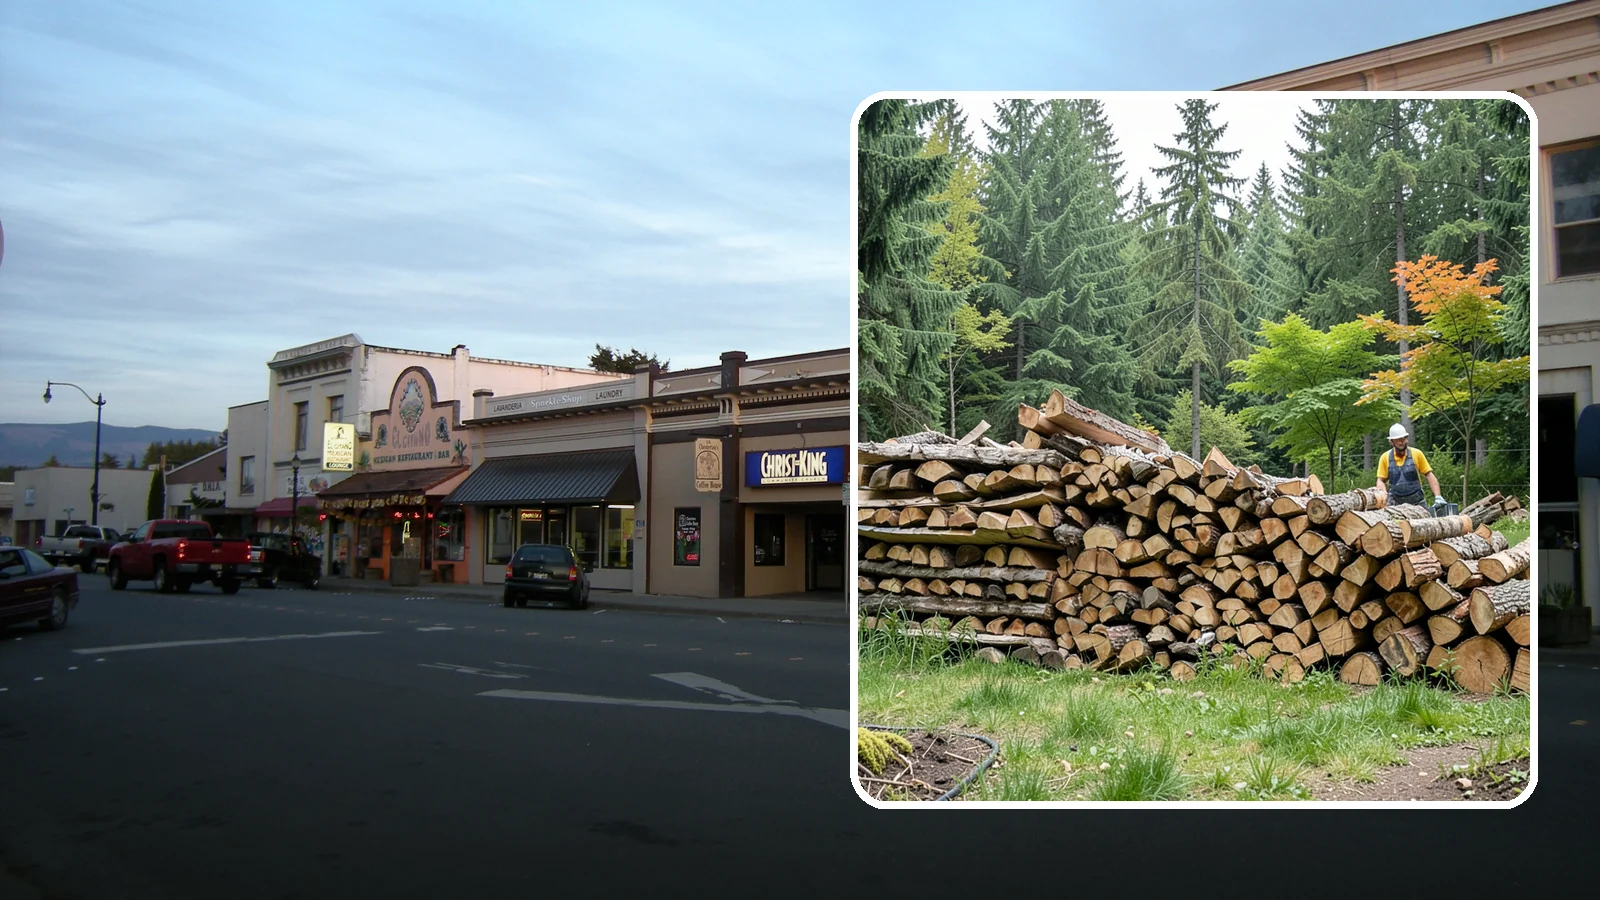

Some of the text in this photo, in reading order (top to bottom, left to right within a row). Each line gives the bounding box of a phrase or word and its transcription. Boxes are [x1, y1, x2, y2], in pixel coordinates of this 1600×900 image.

[595, 389, 624, 400] LAUNDRY
[494, 402, 522, 412] LAVANDERIA
[531, 394, 582, 409] Sparkle Shop
[397, 451, 433, 462] RESTAURANT
[438, 450, 450, 459] BAR
[761, 450, 827, 478] CHRIST KING
[696, 481, 722, 489] Coffee House
